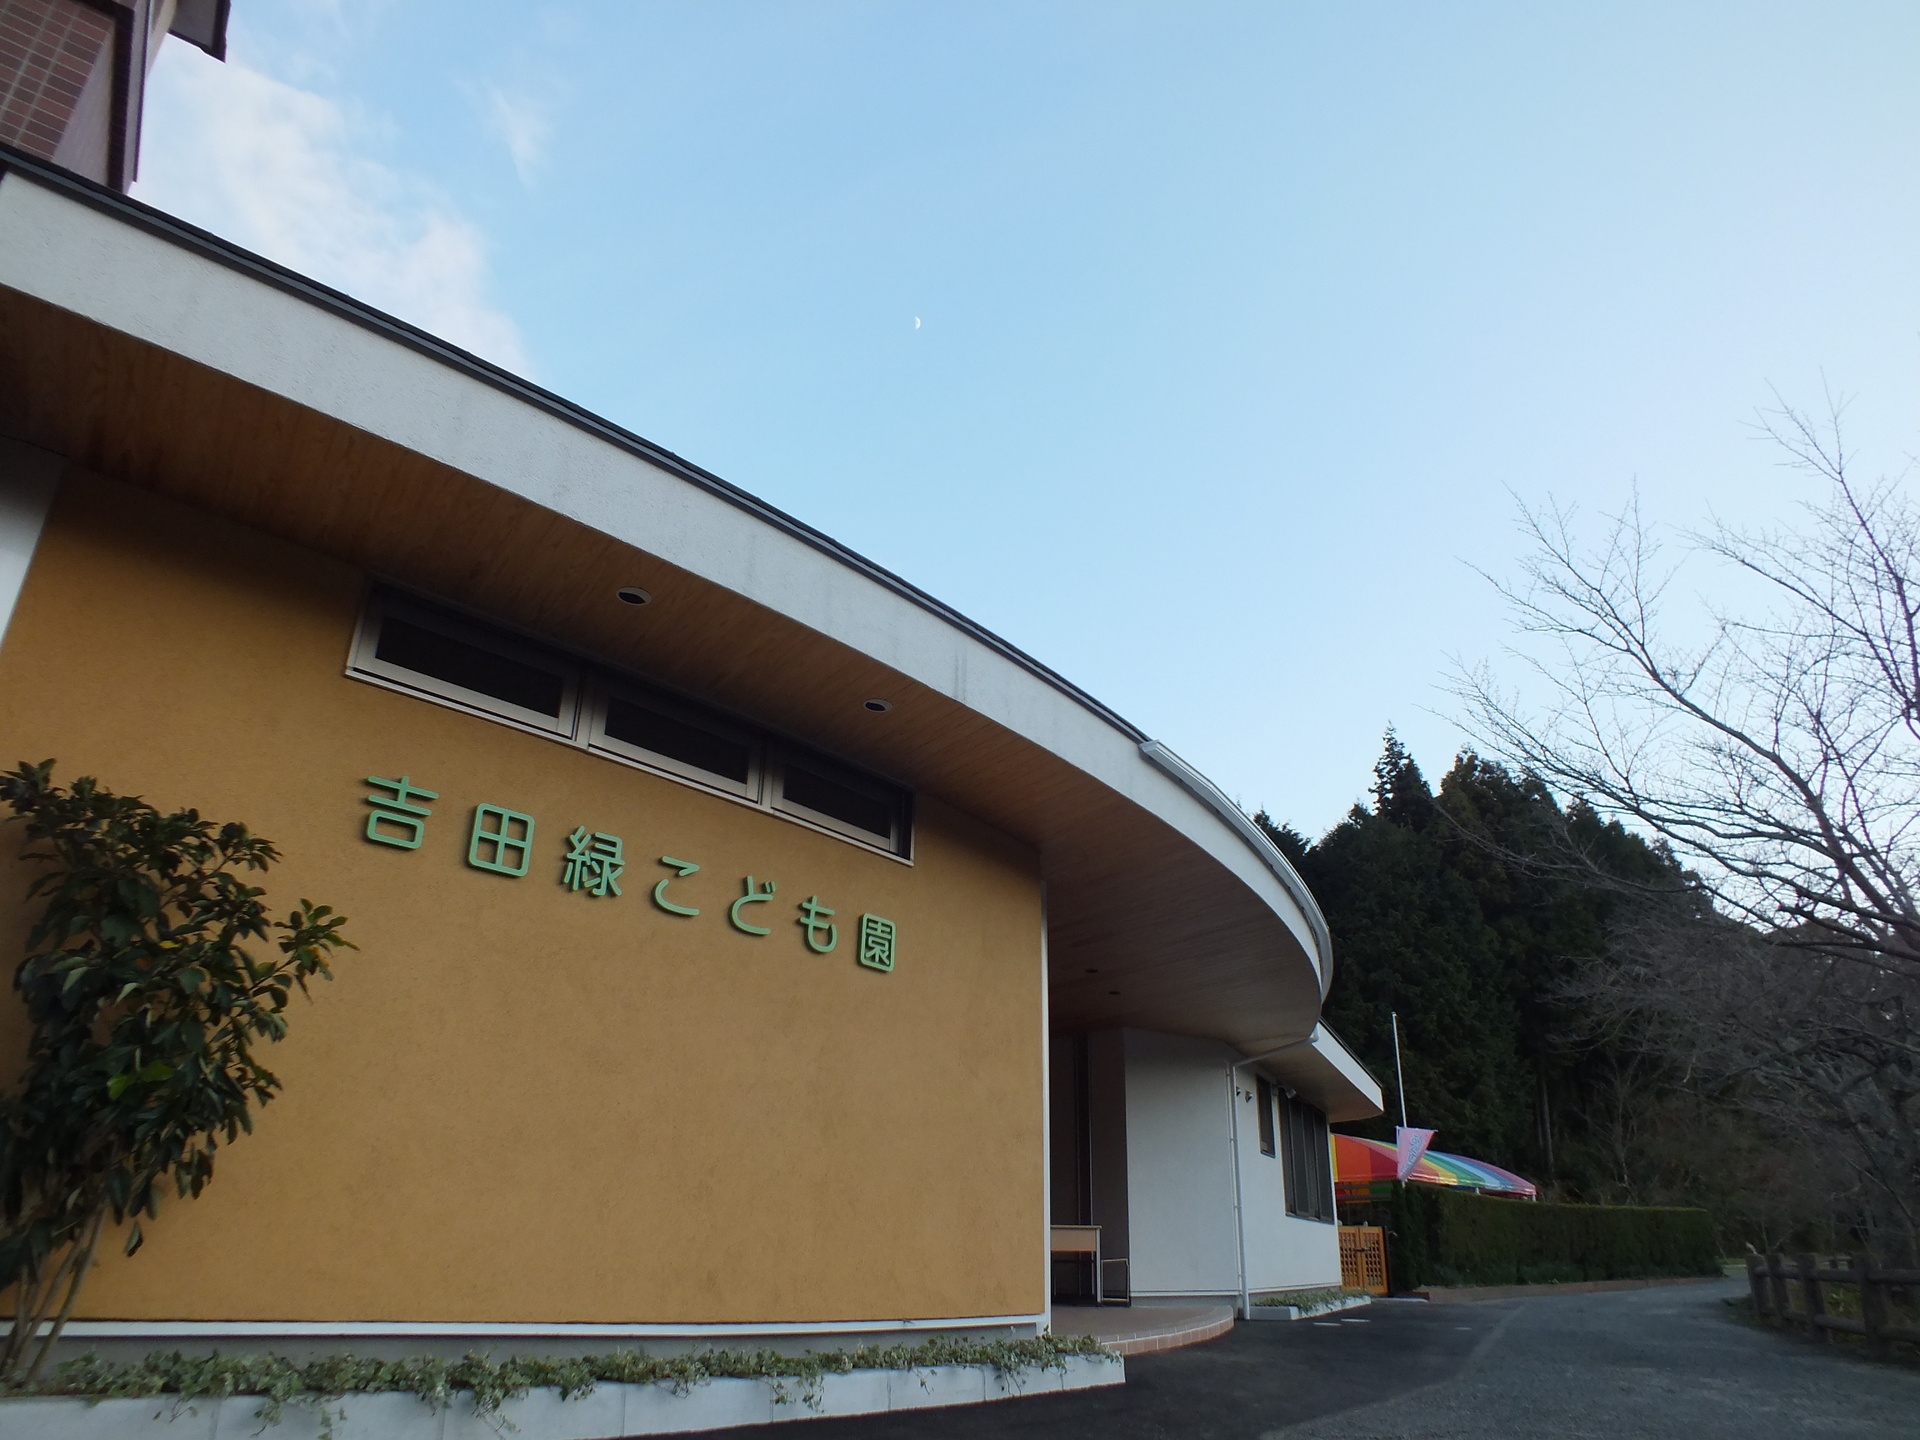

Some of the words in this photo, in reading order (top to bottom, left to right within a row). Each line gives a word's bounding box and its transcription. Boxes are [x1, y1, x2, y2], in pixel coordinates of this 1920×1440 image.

[365, 775, 898, 972] 吉田緑こども園
